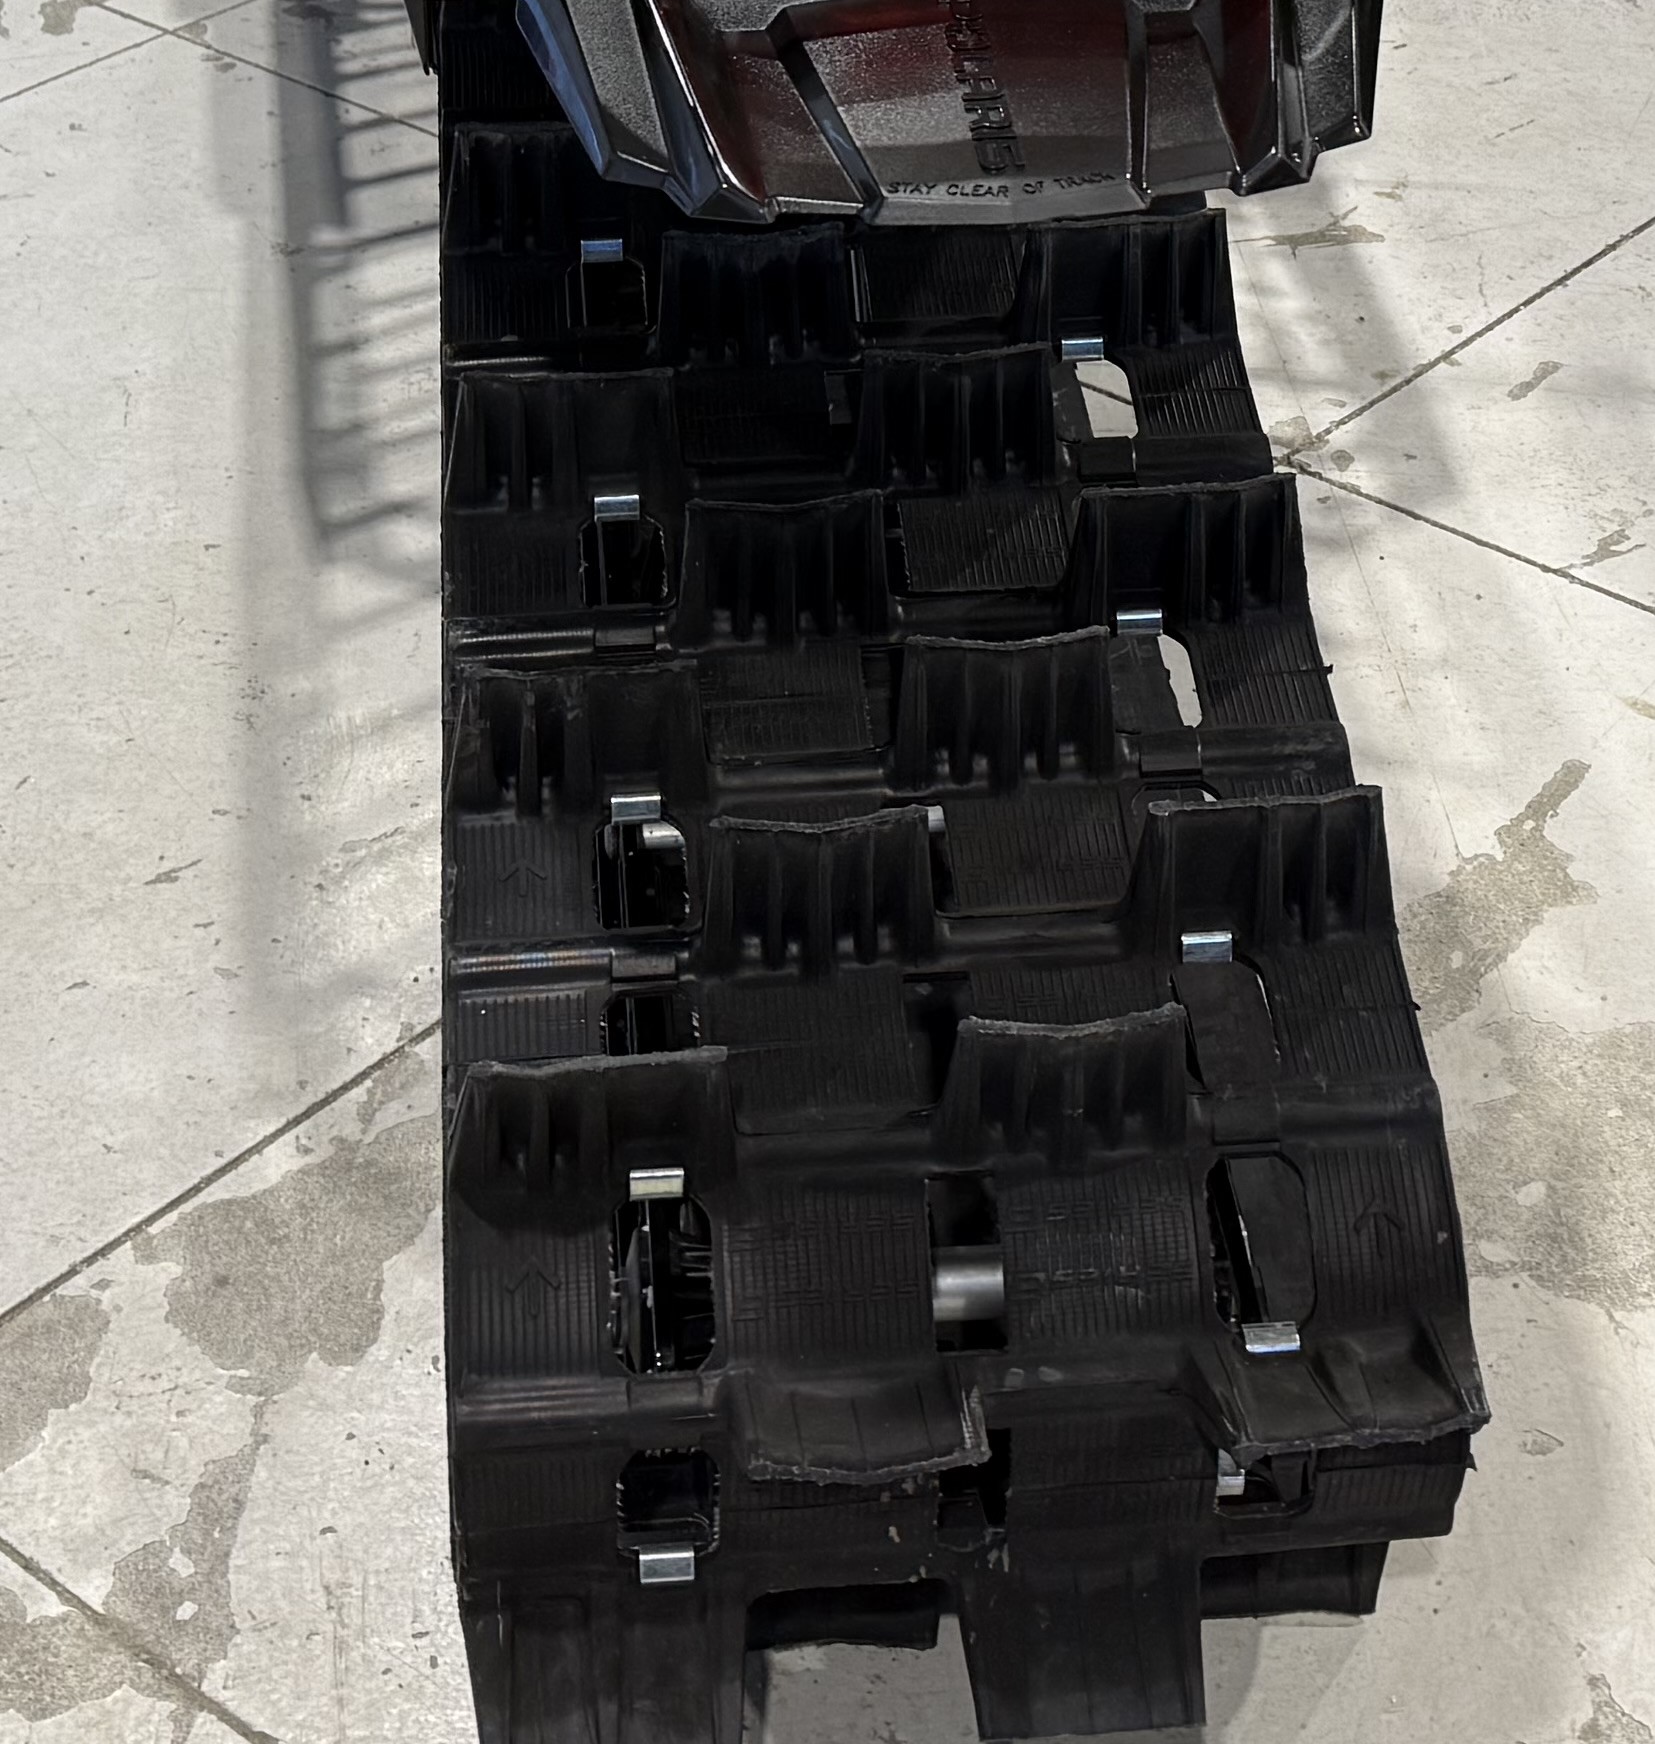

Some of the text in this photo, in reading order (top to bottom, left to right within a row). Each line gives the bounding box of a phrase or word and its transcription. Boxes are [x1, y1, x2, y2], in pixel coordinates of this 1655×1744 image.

[887, 171, 1117, 198] STAY CLEAR OF TRACK
